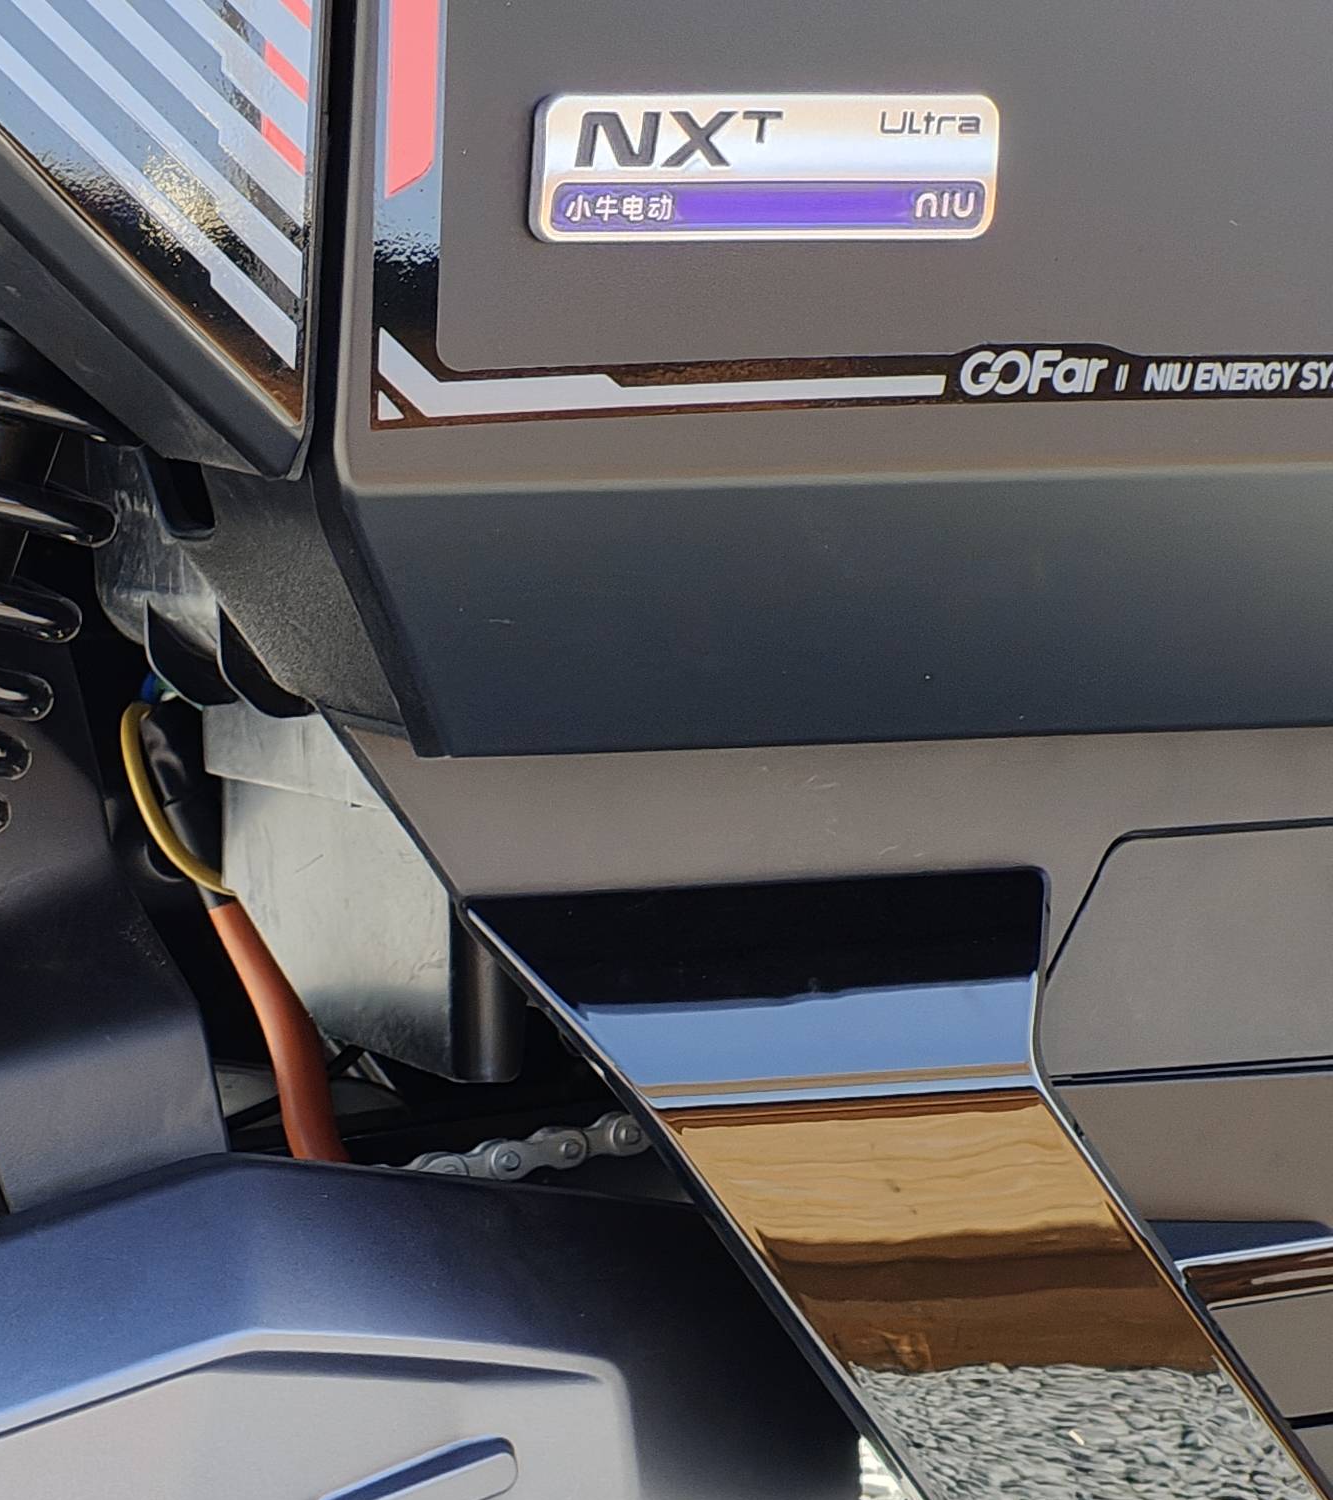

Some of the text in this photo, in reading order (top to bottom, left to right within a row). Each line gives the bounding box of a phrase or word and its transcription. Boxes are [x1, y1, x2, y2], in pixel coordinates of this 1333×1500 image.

[564, 194, 674, 222] 小牛电动
[1142, 362, 1196, 393] NIU
[1192, 361, 1301, 393] ENERGY
[1297, 360, 1333, 391] SY
